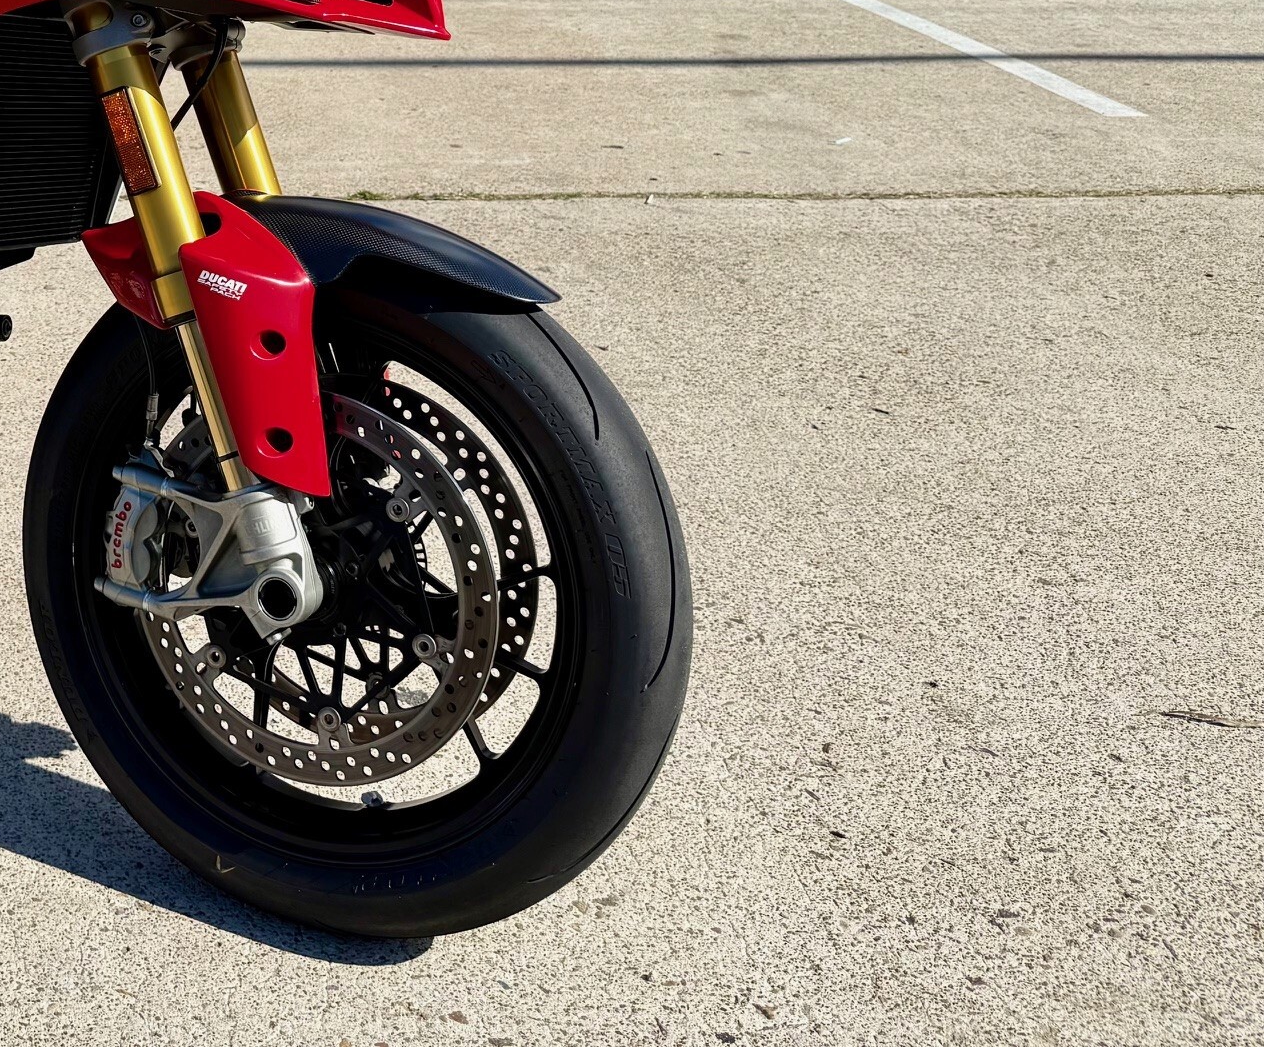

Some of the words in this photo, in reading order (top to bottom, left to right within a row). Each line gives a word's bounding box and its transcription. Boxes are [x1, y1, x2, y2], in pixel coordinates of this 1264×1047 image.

[197, 278, 243, 296] SAFETY
[199, 269, 248, 293] DUCATI
[487, 349, 617, 524] SPORTMAX
[111, 500, 132, 569] brembo
